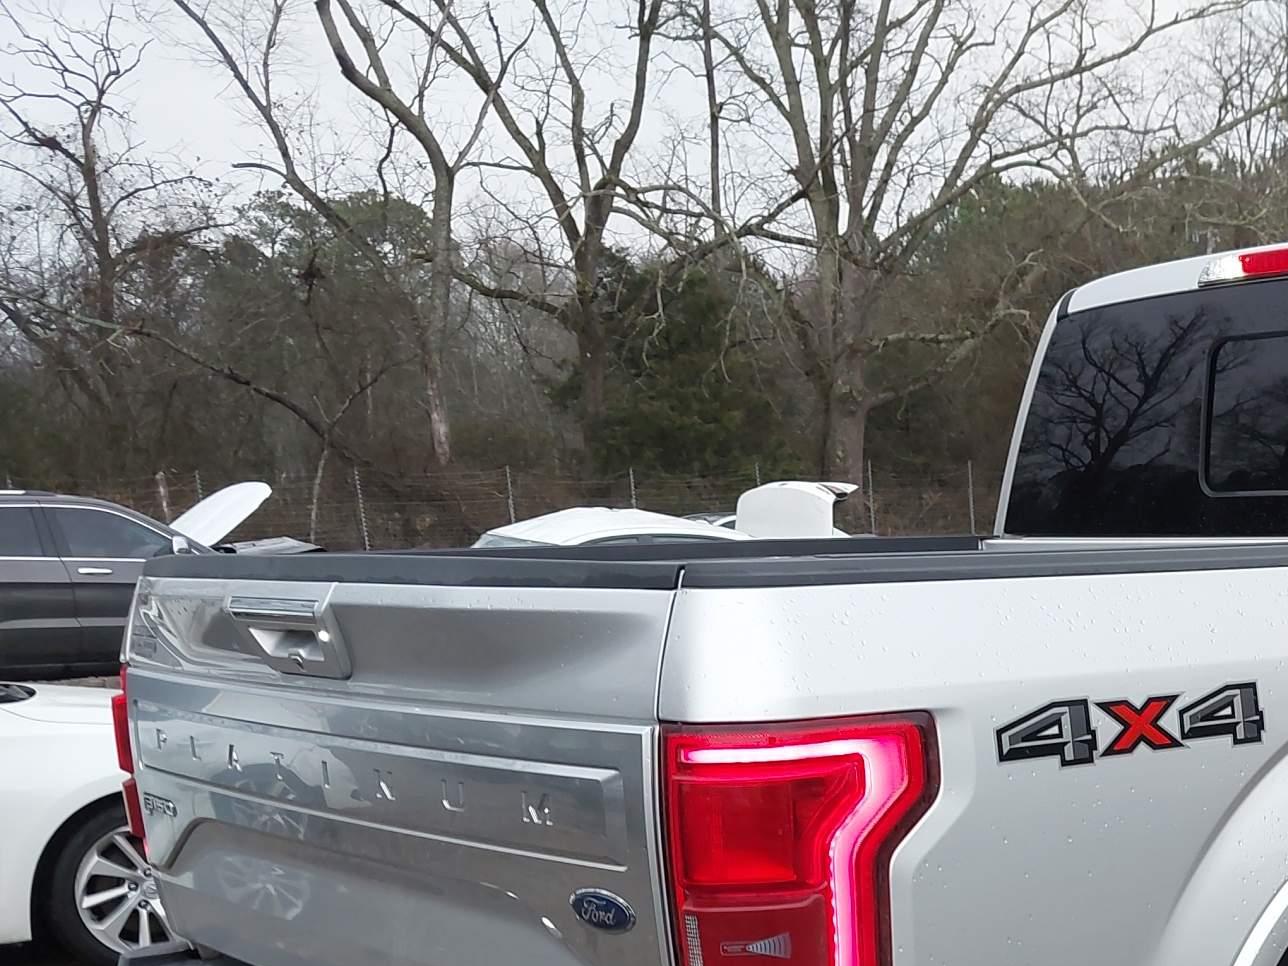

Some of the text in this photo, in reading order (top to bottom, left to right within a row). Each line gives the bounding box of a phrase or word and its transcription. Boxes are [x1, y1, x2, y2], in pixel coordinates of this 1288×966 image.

[993, 680, 1265, 768] 4X4
[155, 727, 554, 827] PLATINUM
[581, 897, 617, 925] Ford
